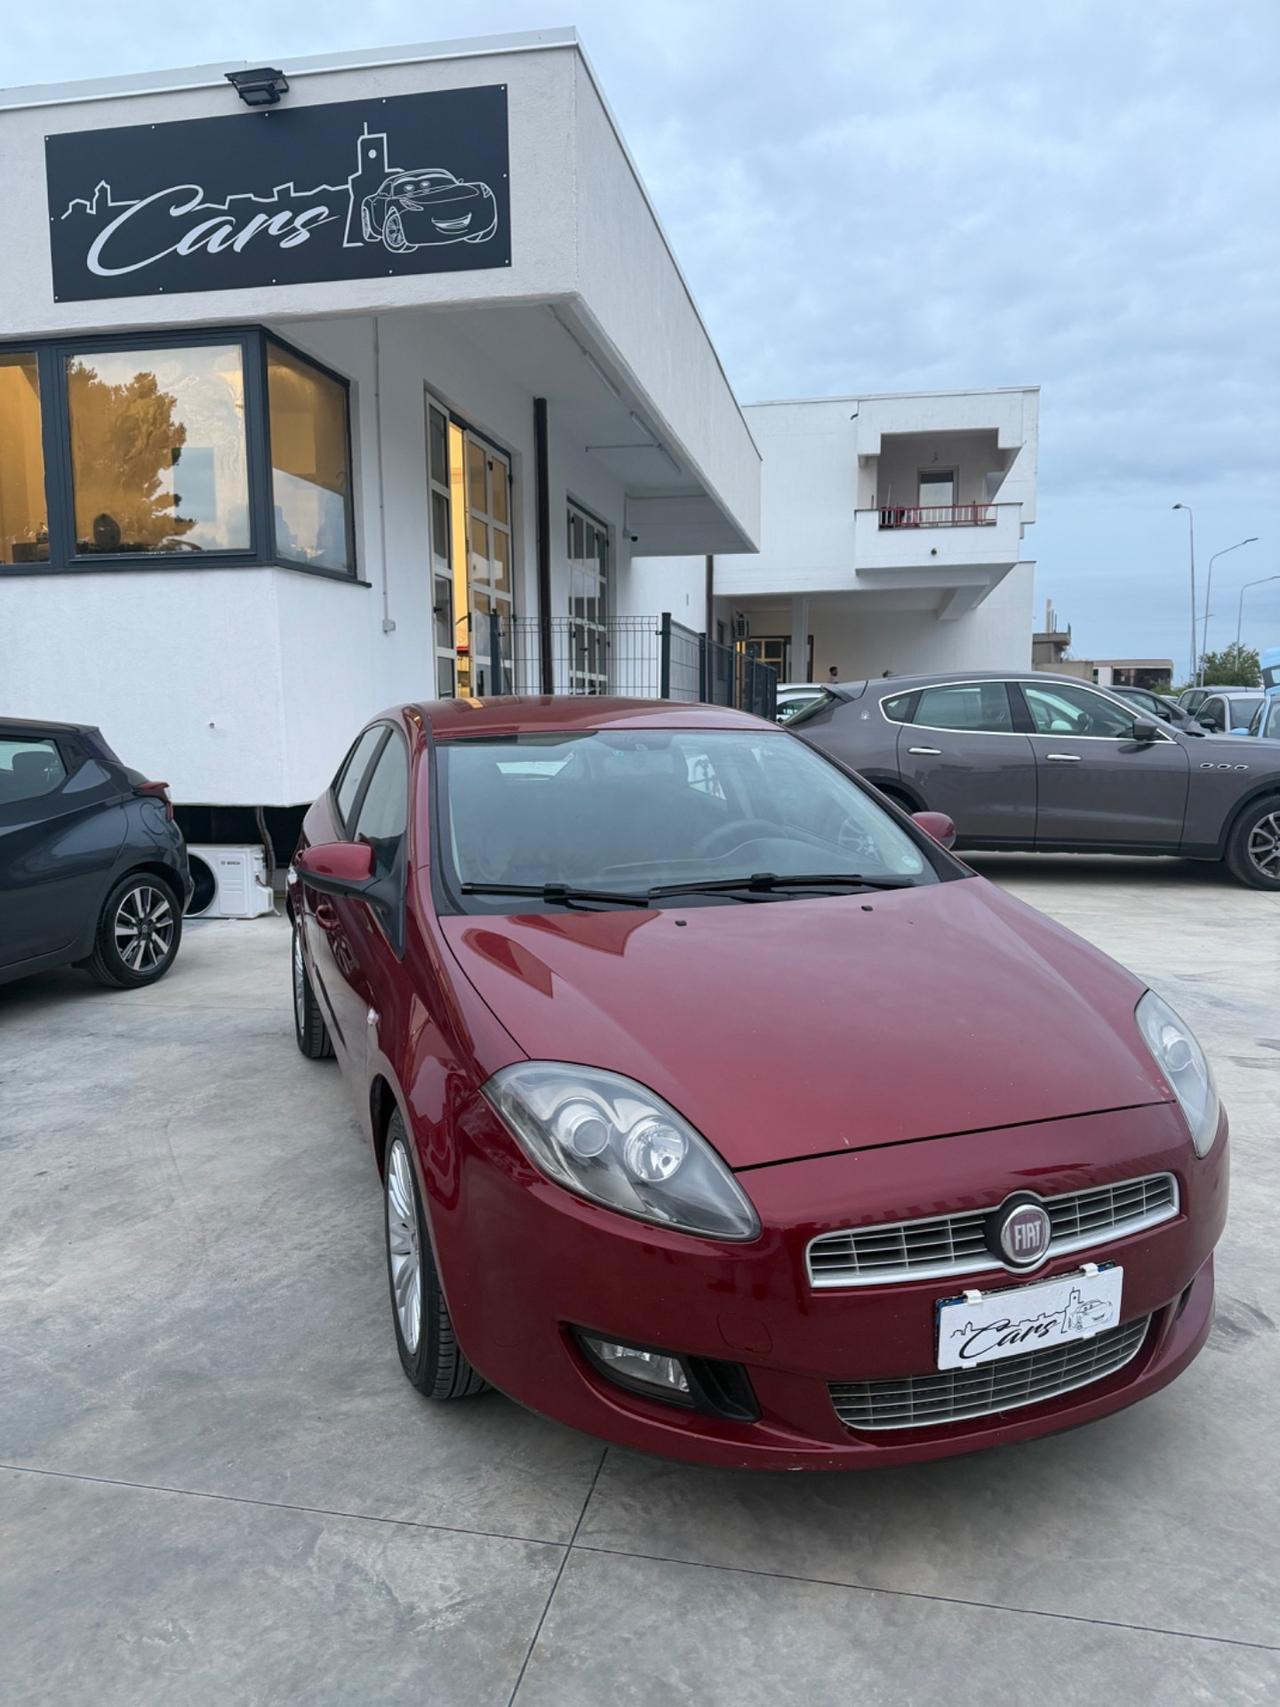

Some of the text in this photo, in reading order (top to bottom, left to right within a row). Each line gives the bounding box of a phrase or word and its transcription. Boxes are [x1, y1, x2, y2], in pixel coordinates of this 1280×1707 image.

[86, 184, 338, 276] Cars
[1014, 1221, 1042, 1250] FIAT
[958, 1318, 1057, 1359] Cars
